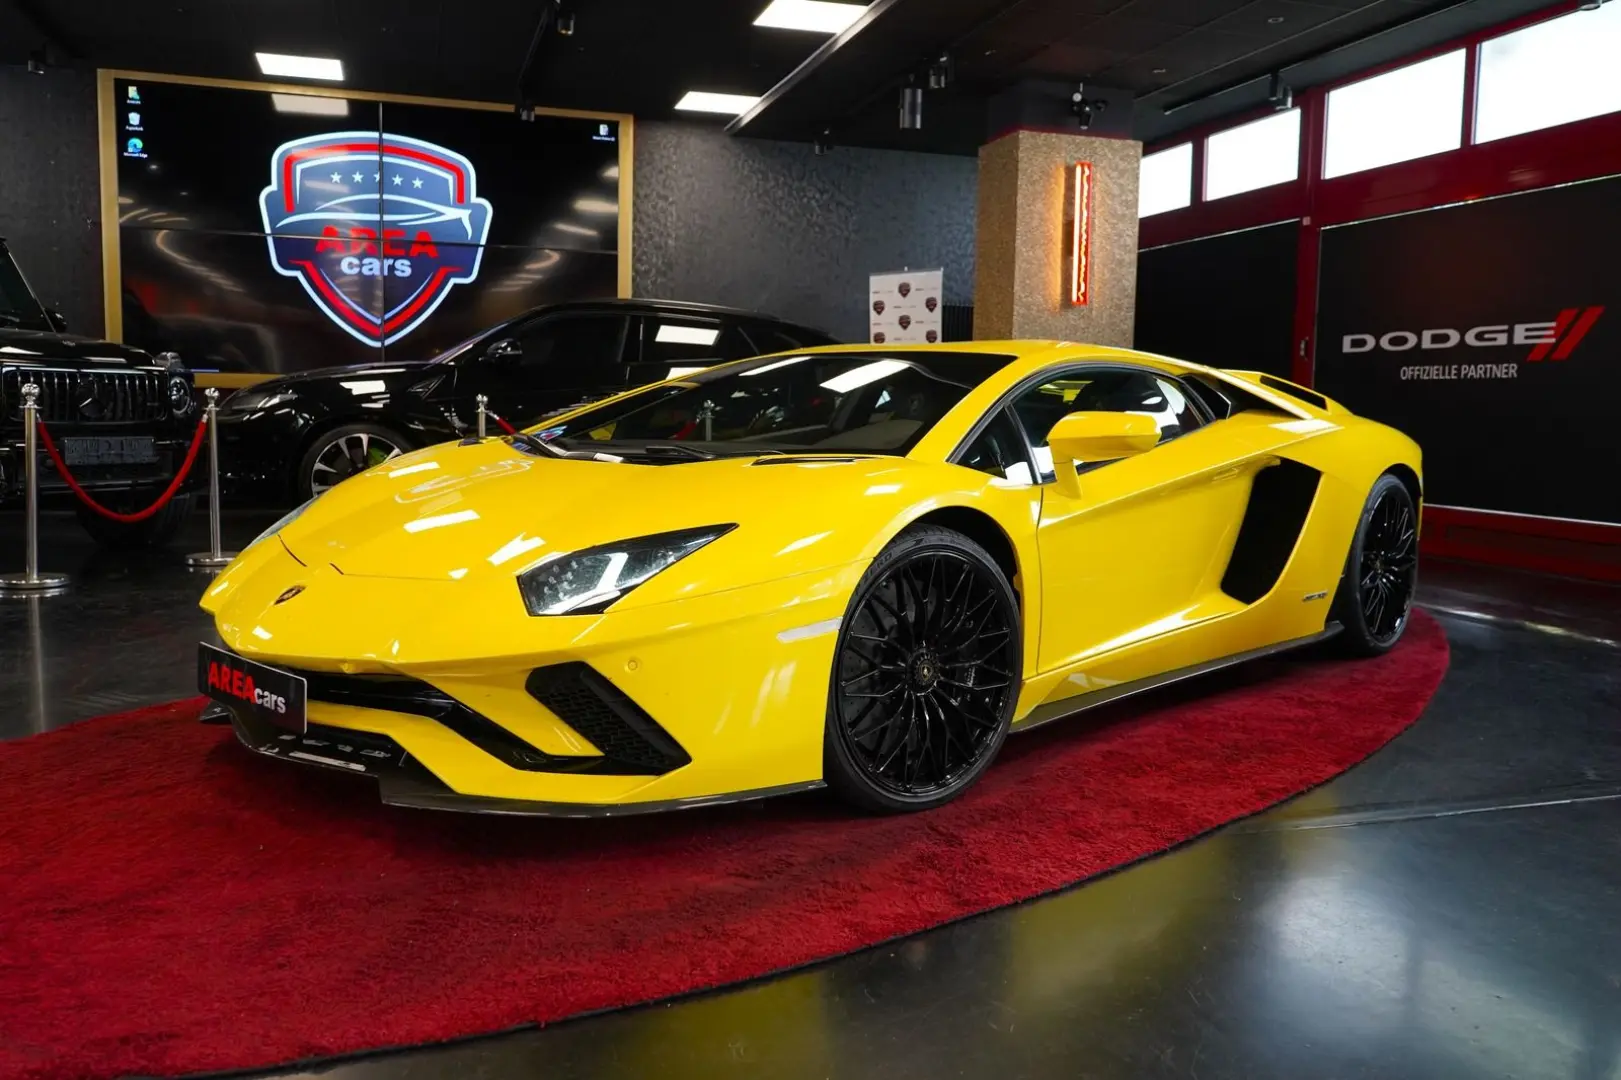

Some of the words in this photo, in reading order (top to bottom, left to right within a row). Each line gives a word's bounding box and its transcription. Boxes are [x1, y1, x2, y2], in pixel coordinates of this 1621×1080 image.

[315, 225, 438, 257] AREA
[340, 256, 412, 277] cars
[1342, 321, 1557, 353] DODGE
[1400, 364, 1458, 381] OFFIZIELLE
[1460, 363, 1518, 379] PARTNER
